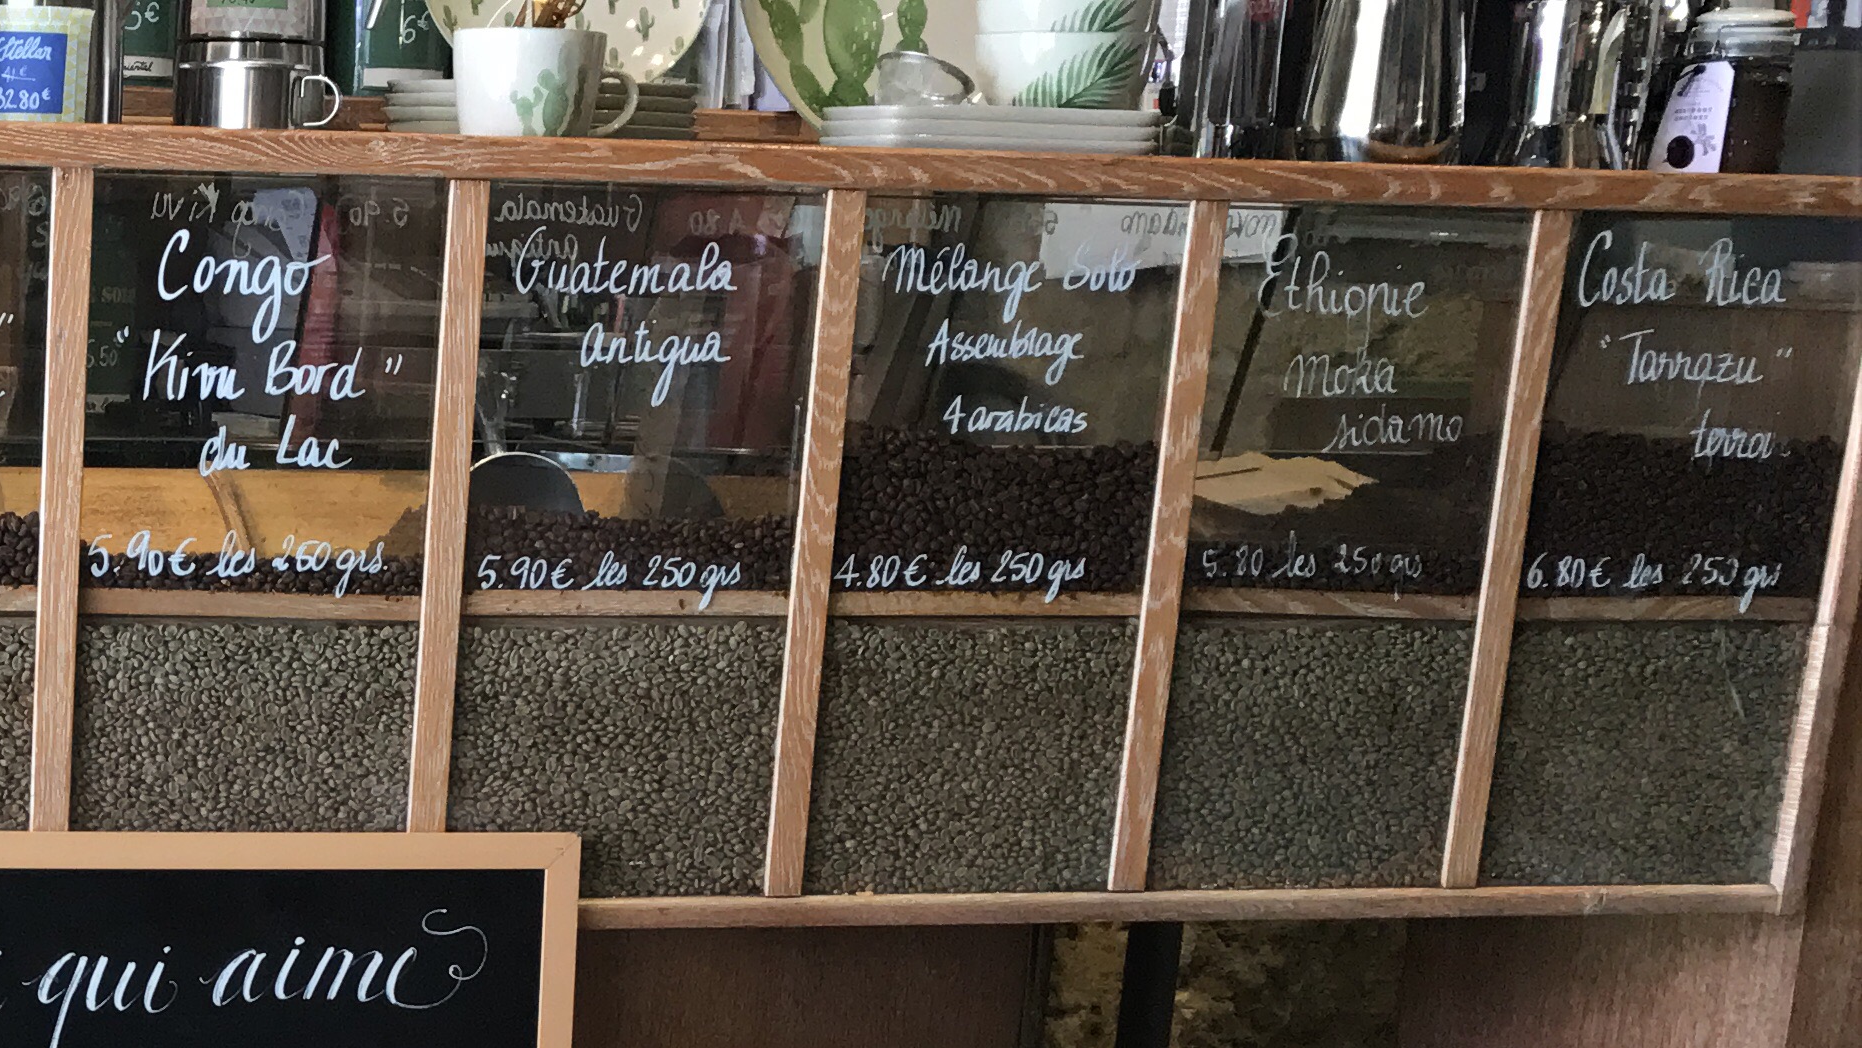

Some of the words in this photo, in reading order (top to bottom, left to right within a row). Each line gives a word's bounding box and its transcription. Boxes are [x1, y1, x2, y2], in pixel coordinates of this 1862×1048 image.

[157, 229, 332, 343] Congo
[514, 226, 737, 294] Guatemala
[882, 242, 1043, 324] Mélange
[1579, 230, 1675, 307] Costa
[1698, 237, 1786, 307] Rica
[925, 318, 1084, 386] Assemblage
[200, 426, 250, 477] du
[276, 414, 352, 470] Lac
[207, 530, 256, 577] les
[477, 554, 574, 590] 5.90€
[582, 551, 628, 590] les
[642, 554, 697, 587] 250
[698, 560, 741, 610] grs
[834, 553, 927, 589] 4.80€
[936, 545, 980, 588] les
[990, 551, 1044, 583] 250
[1045, 556, 1085, 603] grs
[1272, 530, 1316, 579] les
[1527, 552, 1611, 589] 6.80€
[1623, 553, 1663, 589] les
[1681, 554, 1738, 587] 250
[1742, 560, 1782, 613] grs
[201, 908, 488, 1010] aime
